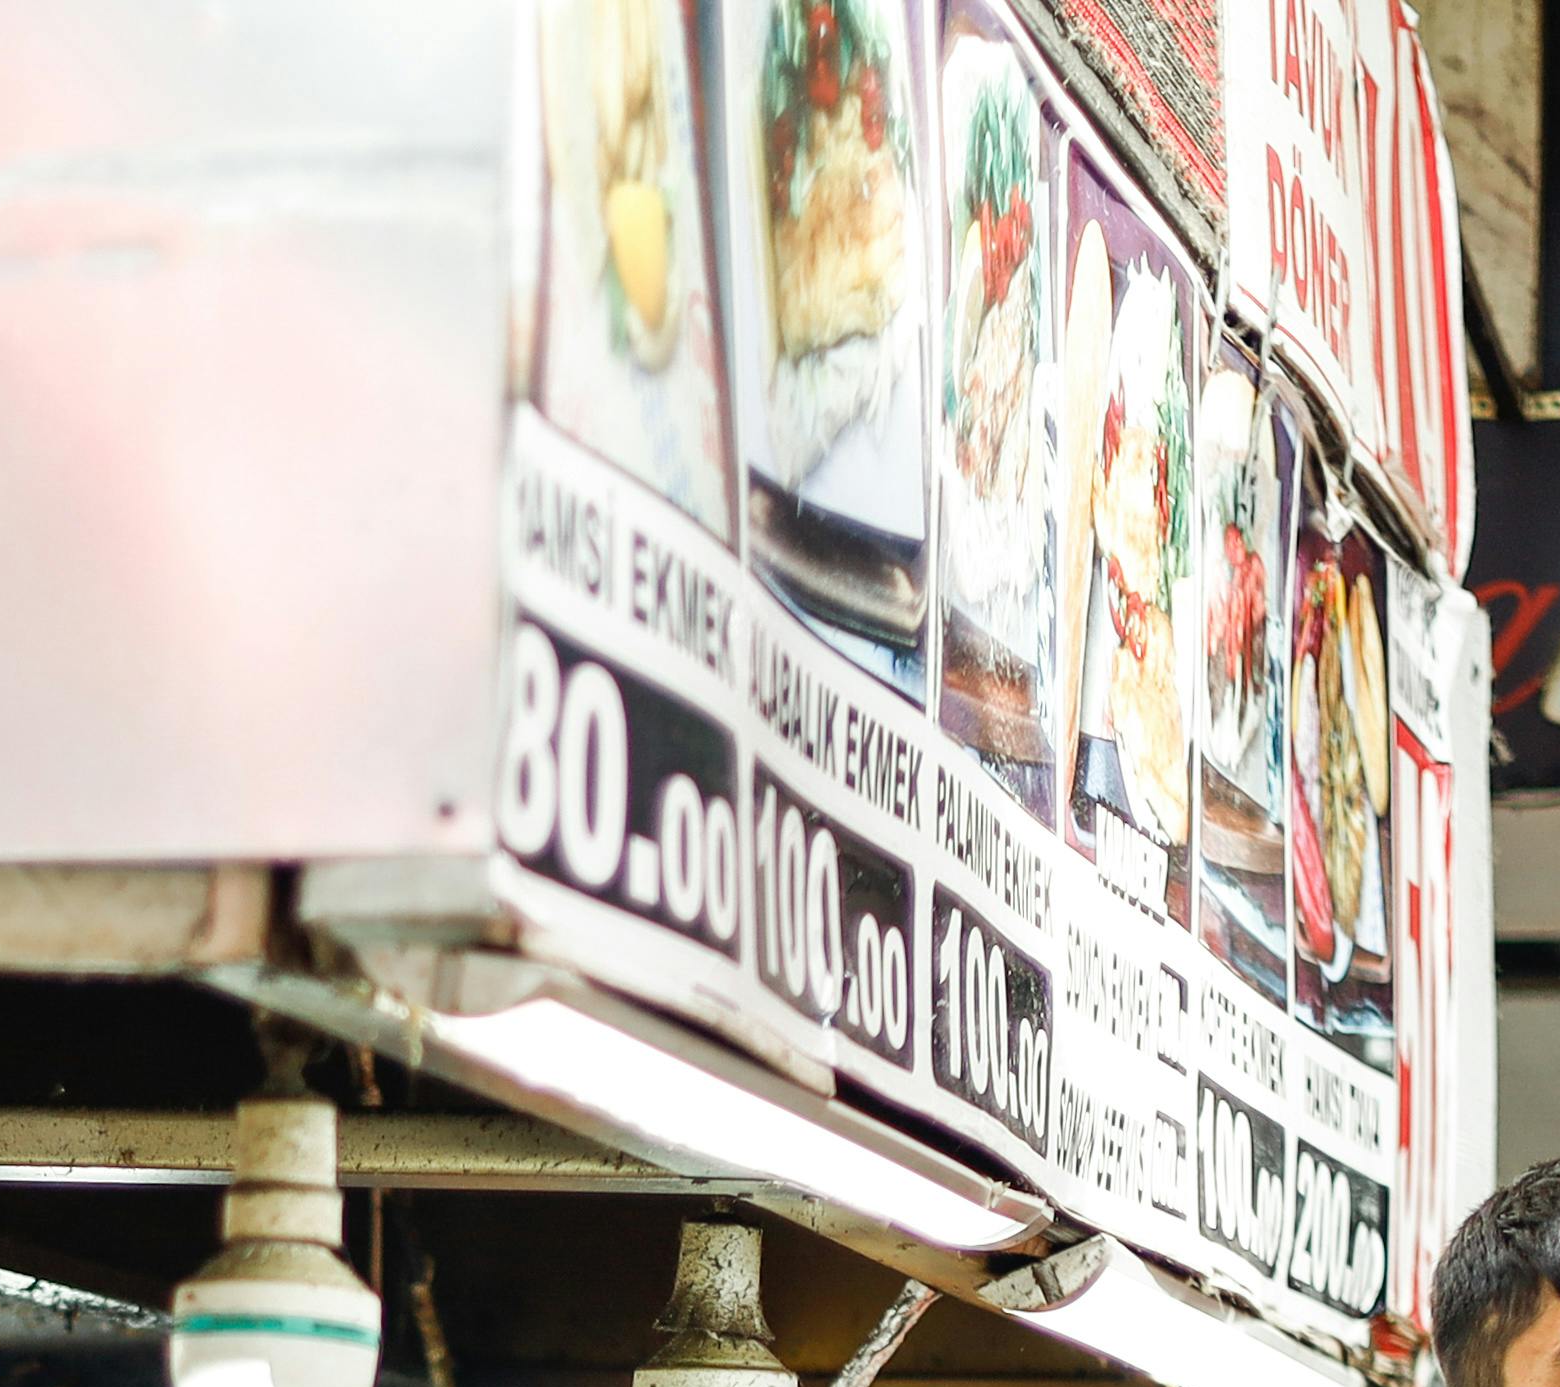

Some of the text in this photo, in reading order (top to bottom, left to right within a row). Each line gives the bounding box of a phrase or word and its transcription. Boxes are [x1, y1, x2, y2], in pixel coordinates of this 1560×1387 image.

[1266, 143, 1353, 387] DÖNER
[632, 527, 736, 688] EKMEK
[497, 628, 738, 942] 80.00
[747, 617, 924, 832] ALABALIK EKMEK
[756, 783, 909, 1053] 100.00
[936, 763, 1001, 895] PALAMUT
[1004, 838, 1055, 938] EKMEK
[940, 908, 1049, 1137] 100.00
